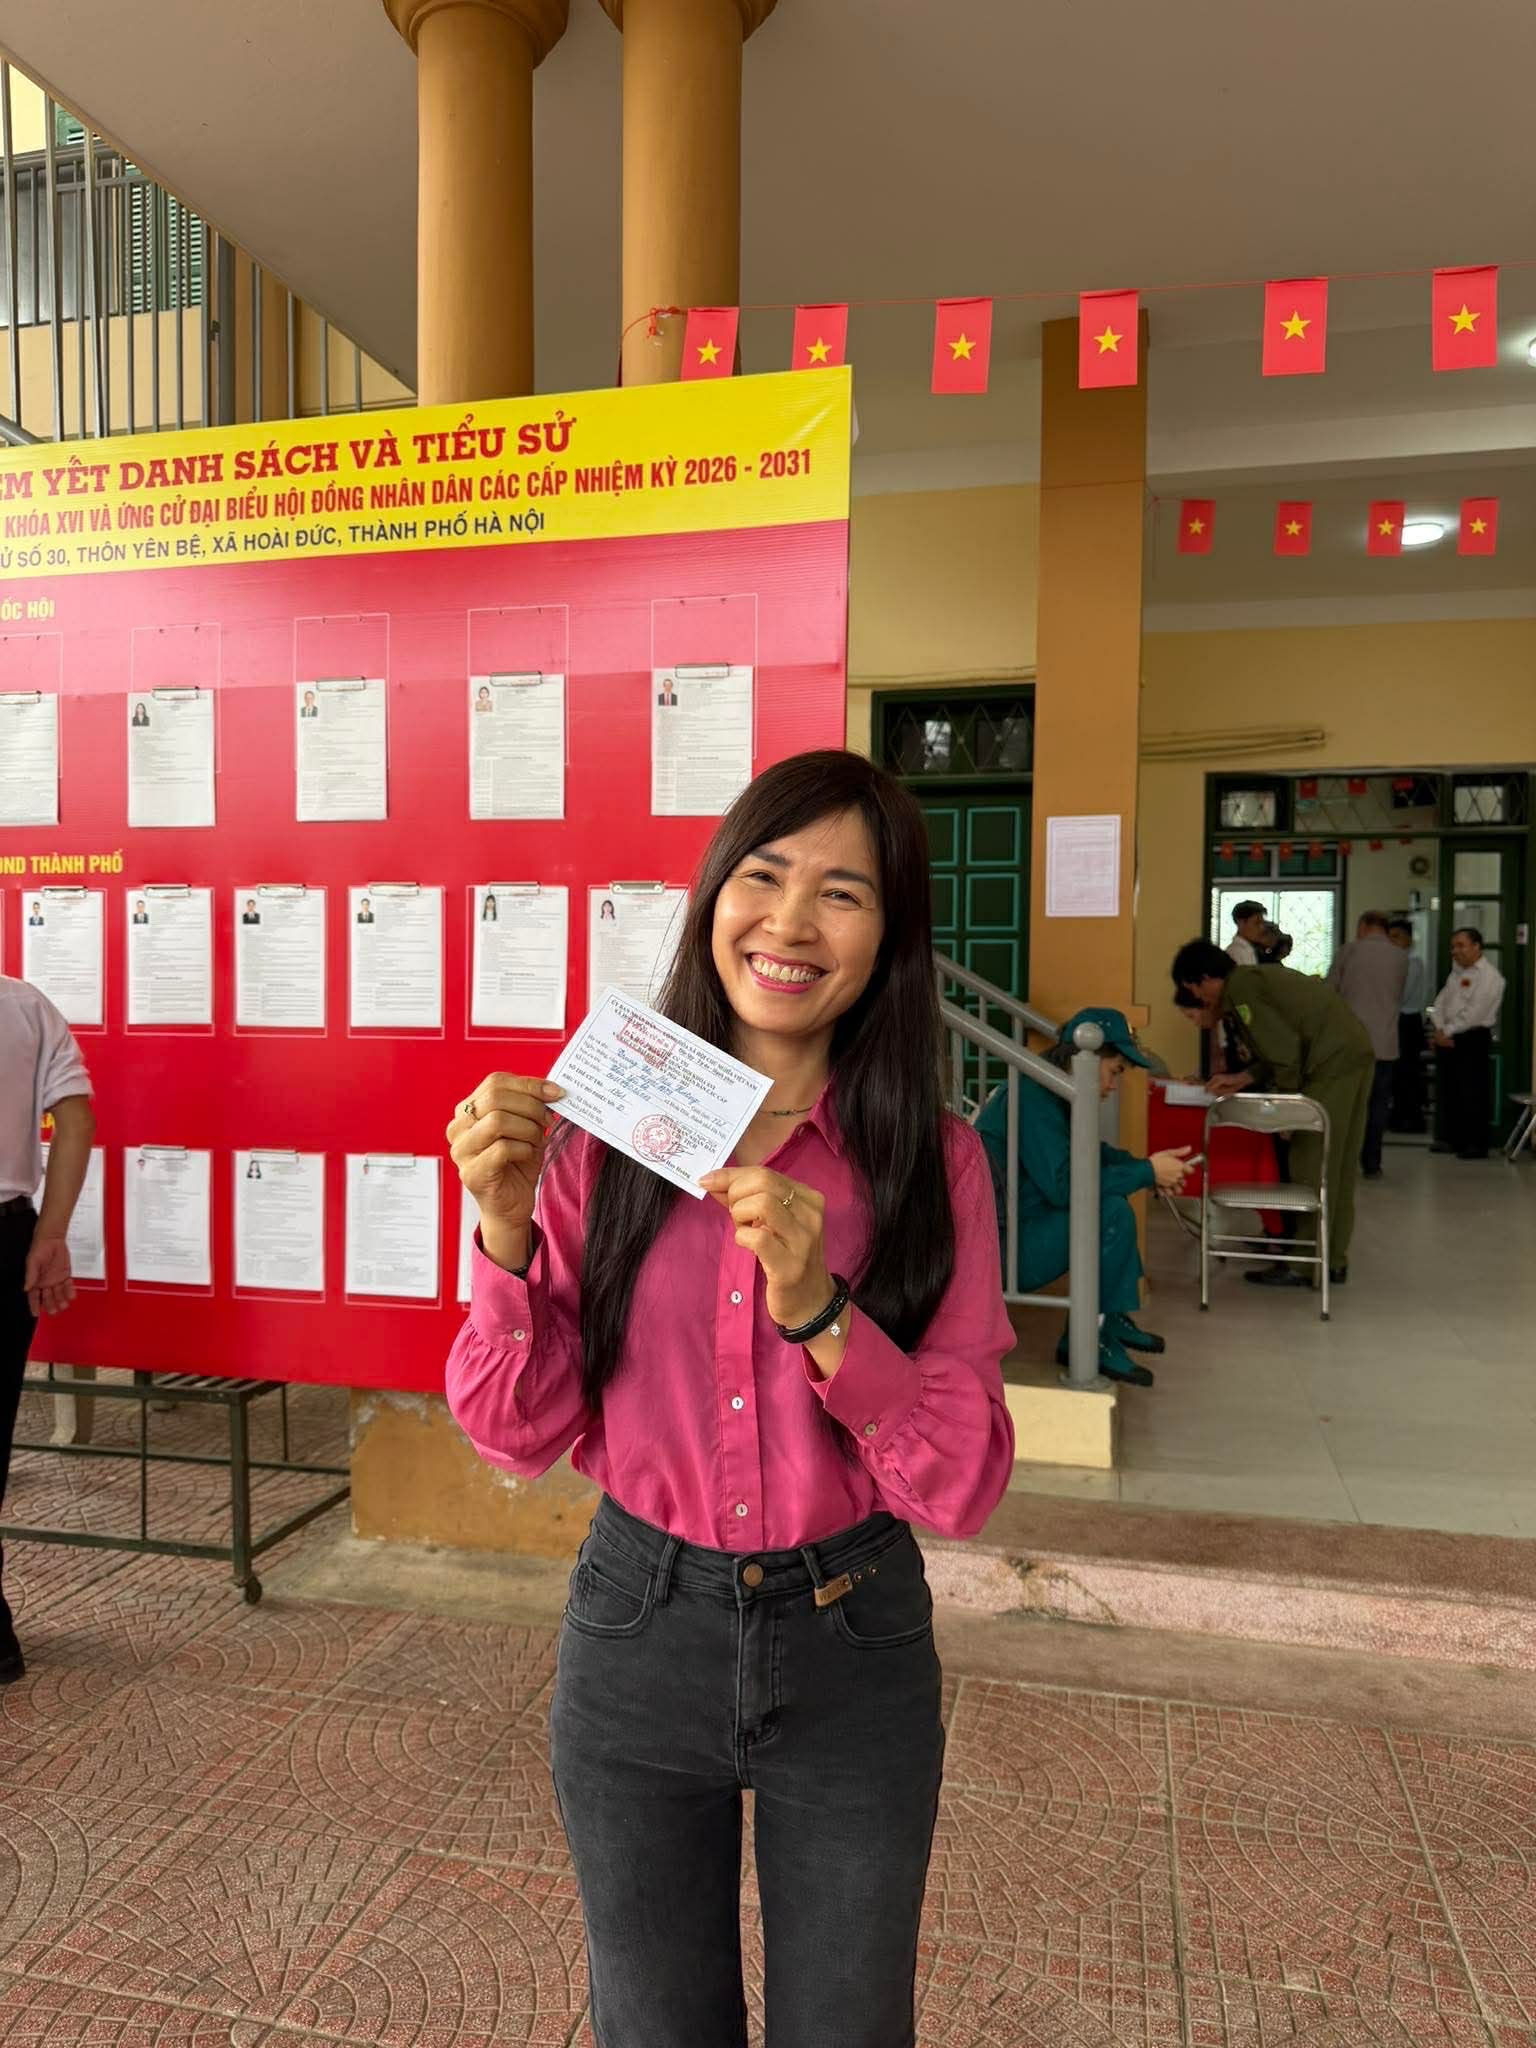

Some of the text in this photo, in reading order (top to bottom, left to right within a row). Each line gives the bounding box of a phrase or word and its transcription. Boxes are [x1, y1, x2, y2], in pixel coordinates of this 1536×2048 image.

[43, 454, 110, 496] YẾT
[119, 453, 223, 490] DANH
[234, 440, 338, 480] SÁCH
[349, 429, 401, 469] VÀ
[412, 413, 506, 464] TIỂU
[518, 410, 577, 455] SỬ
[5, 509, 50, 538] KHÓA
[56, 510, 84, 534] XVI
[90, 504, 111, 532] VÀ
[118, 502, 154, 530] ỨNG
[160, 494, 186, 526] CỬ
[190, 499, 220, 527] ĐẠI
[226, 486, 268, 521] BIỂU
[274, 487, 305, 521] HỘI
[311, 480, 364, 513] ĐỒNG
[370, 477, 425, 509] NHÂN
[432, 473, 472, 504] DÂN
[480, 469, 520, 500] CÁC
[527, 461, 567, 497] CẤP
[575, 460, 643, 496] NHIỆM
[651, 455, 678, 488] KỲ
[685, 456, 736, 485] 2026
[760, 449, 810, 478] 2031
[17, 544, 42, 568] SỐ
[47, 549, 70, 568] 30,
[77, 541, 126, 563] THÔN
[133, 538, 169, 559] YÊN
[176, 534, 206, 558] BỆ,
[213, 532, 237, 553] XÃ
[244, 527, 289, 551] HOÀI
[296, 524, 341, 547] ĐỨC,
[349, 519, 417, 542] THÀNH
[425, 511, 468, 537] PHỐ
[475, 511, 502, 534] HÀ
[510, 508, 544, 534] NỘI
[27, 596, 55, 621] HỘI
[31, 852, 85, 874] THÀNH
[88, 848, 123, 874] PHỐ
